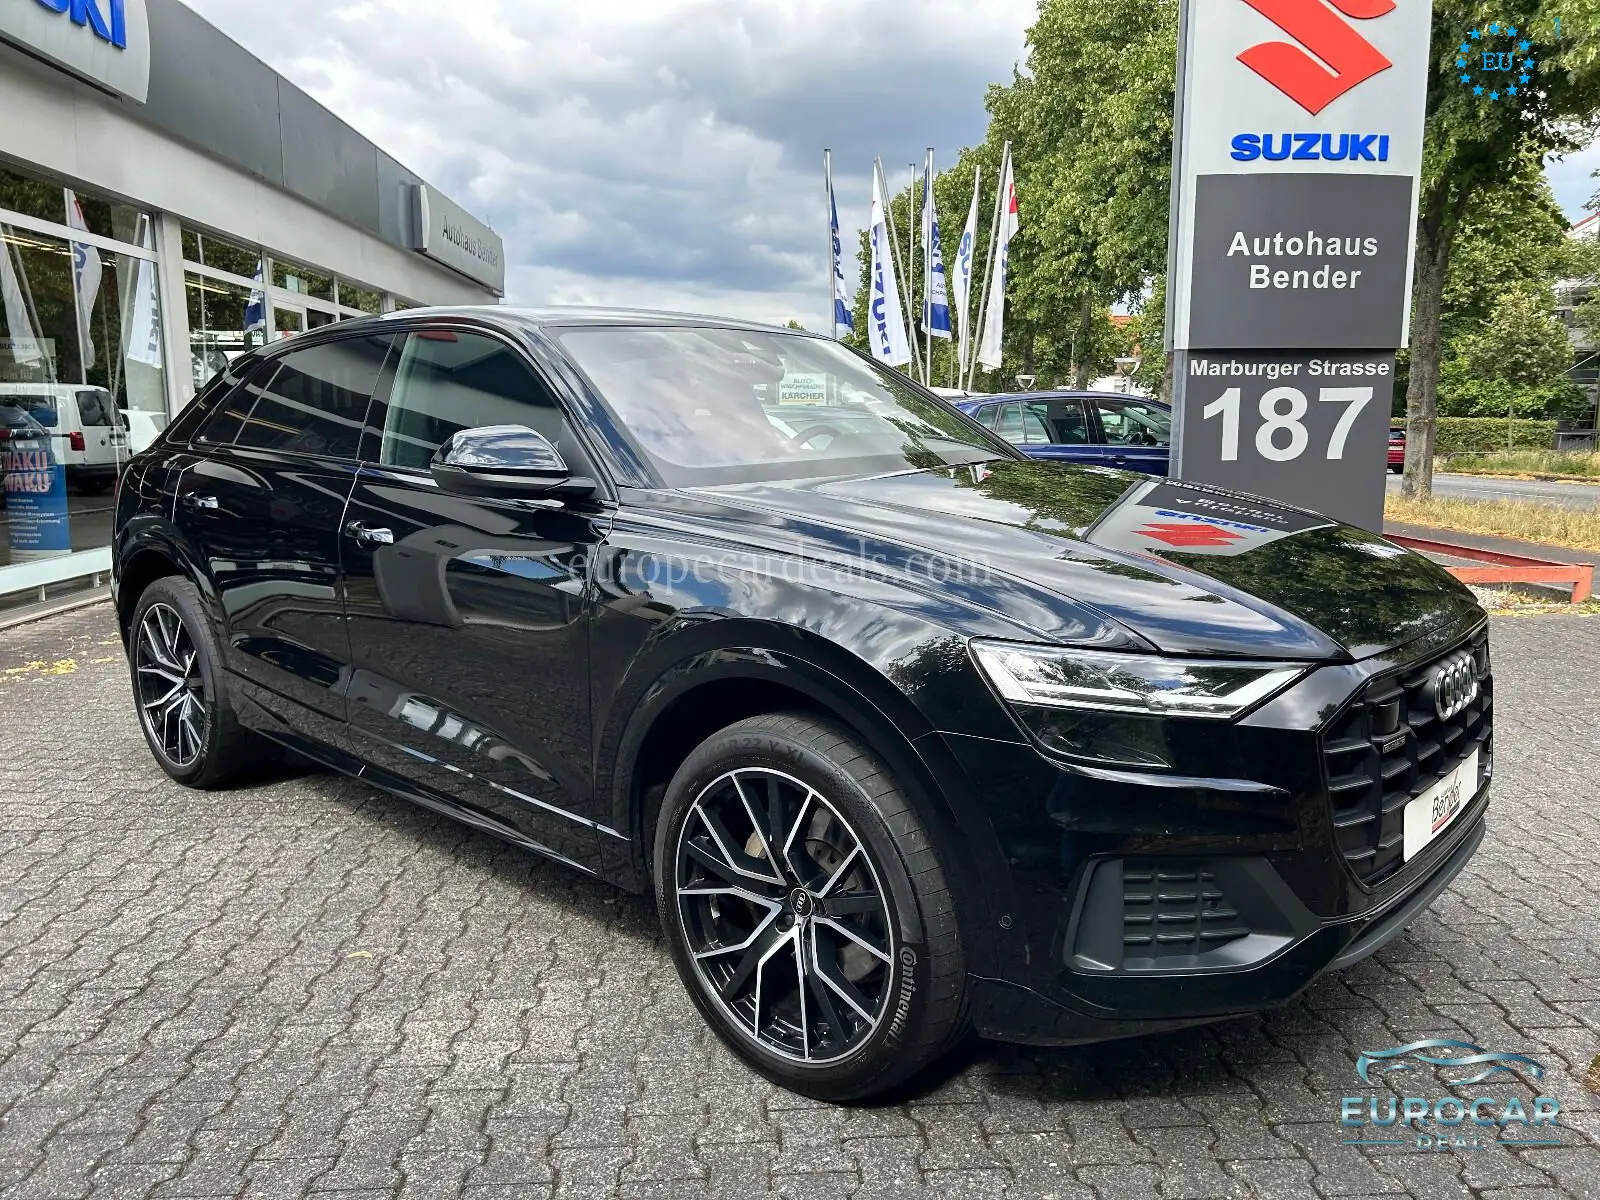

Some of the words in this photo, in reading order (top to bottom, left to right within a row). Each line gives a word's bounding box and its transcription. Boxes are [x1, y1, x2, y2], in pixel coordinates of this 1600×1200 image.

[1230, 133, 1389, 161] SUZUKI
[442, 215, 477, 256] Autohaus
[1227, 231, 1378, 256] Autohaus
[1249, 264, 1361, 289] Bender
[1190, 359, 1302, 379] Marburger
[1308, 359, 1390, 376] Strasse
[1203, 386, 1374, 462] 187
[890, 946, 917, 1040] Continental
